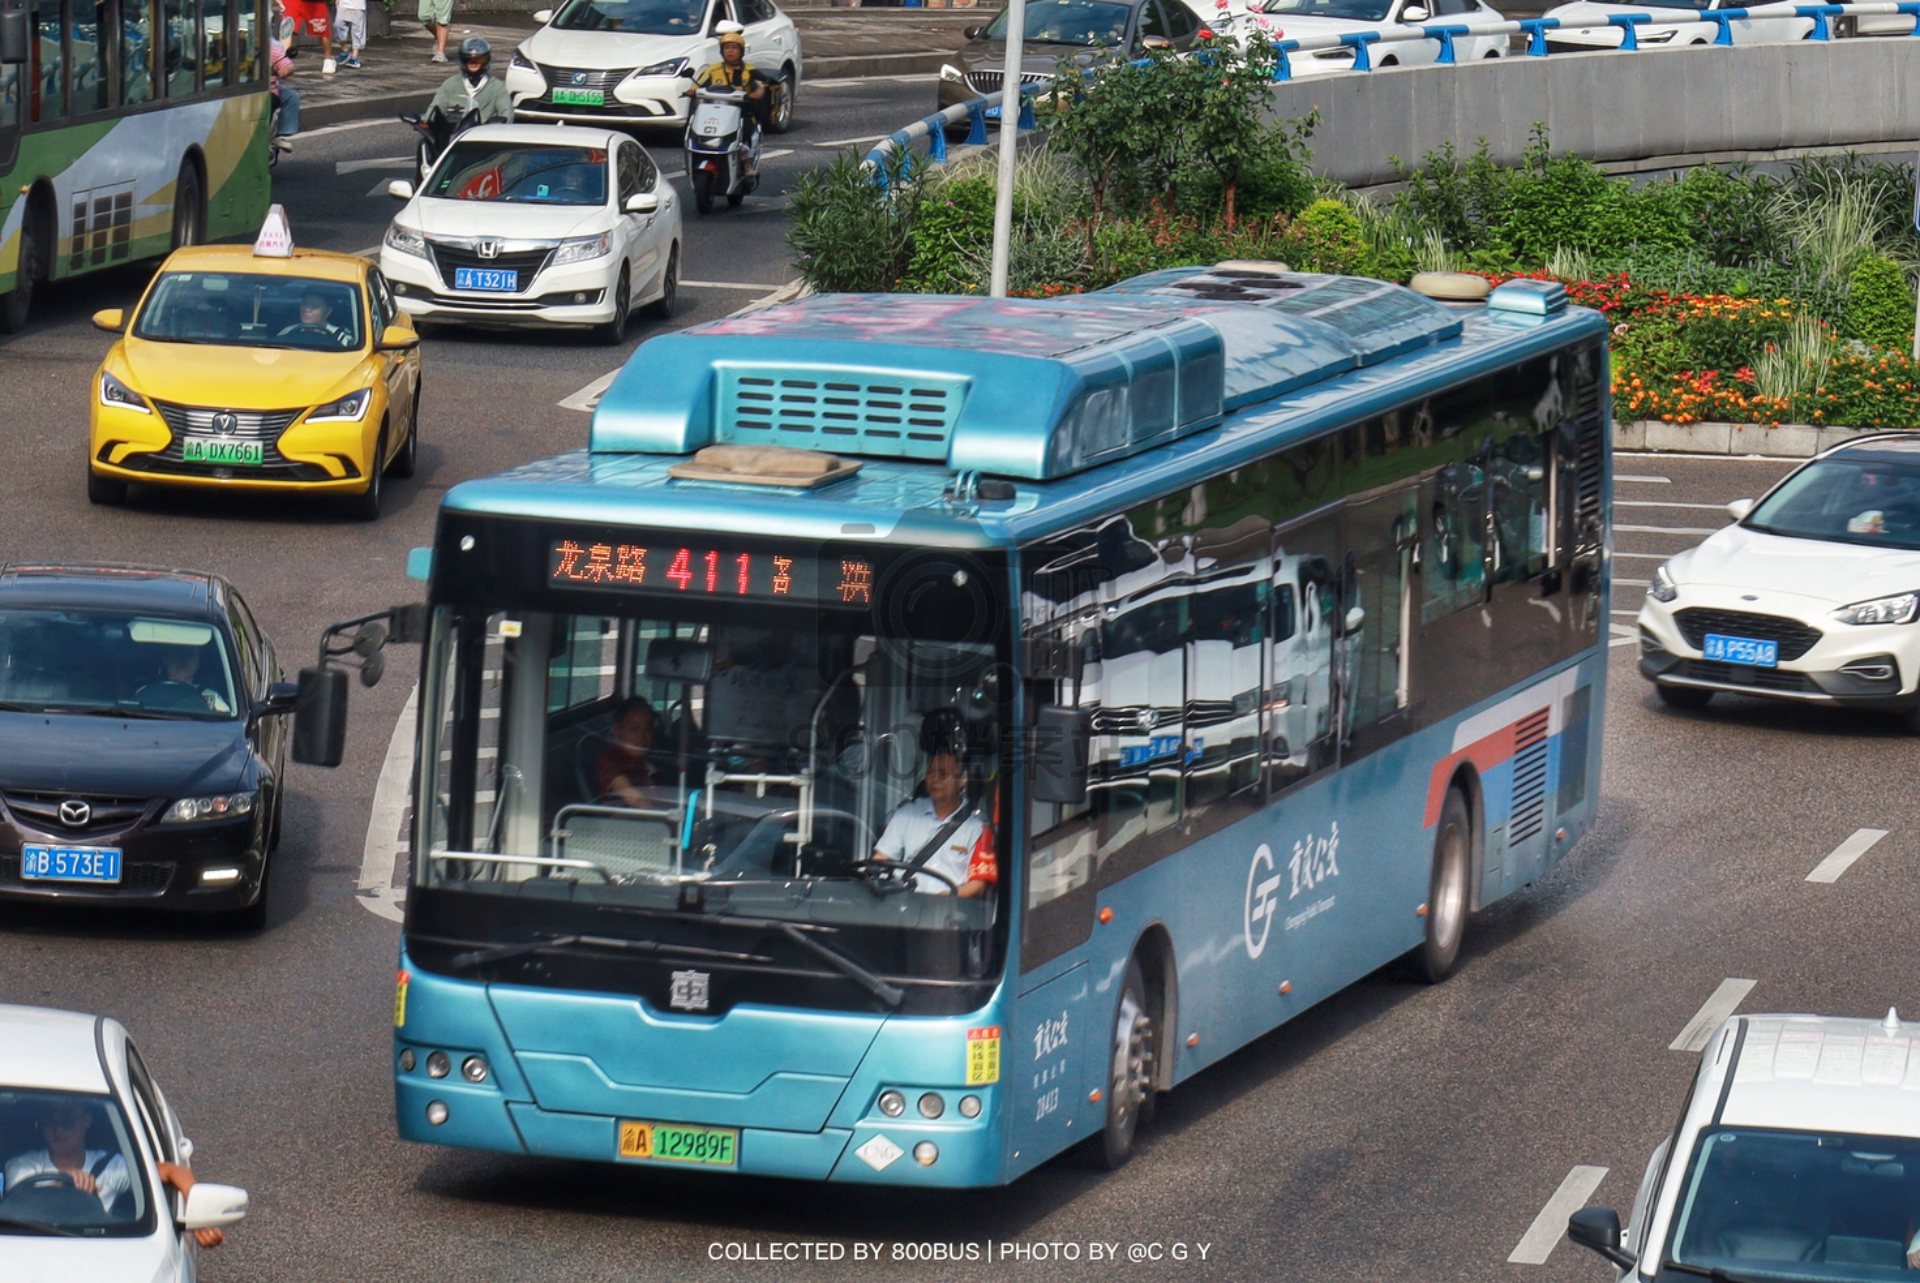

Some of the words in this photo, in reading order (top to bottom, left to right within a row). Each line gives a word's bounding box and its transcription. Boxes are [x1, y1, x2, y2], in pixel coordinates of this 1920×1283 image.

[553, 540, 648, 584] 龙泉路
[666, 548, 750, 596] 411
[864, 1144, 896, 1161] CNG
